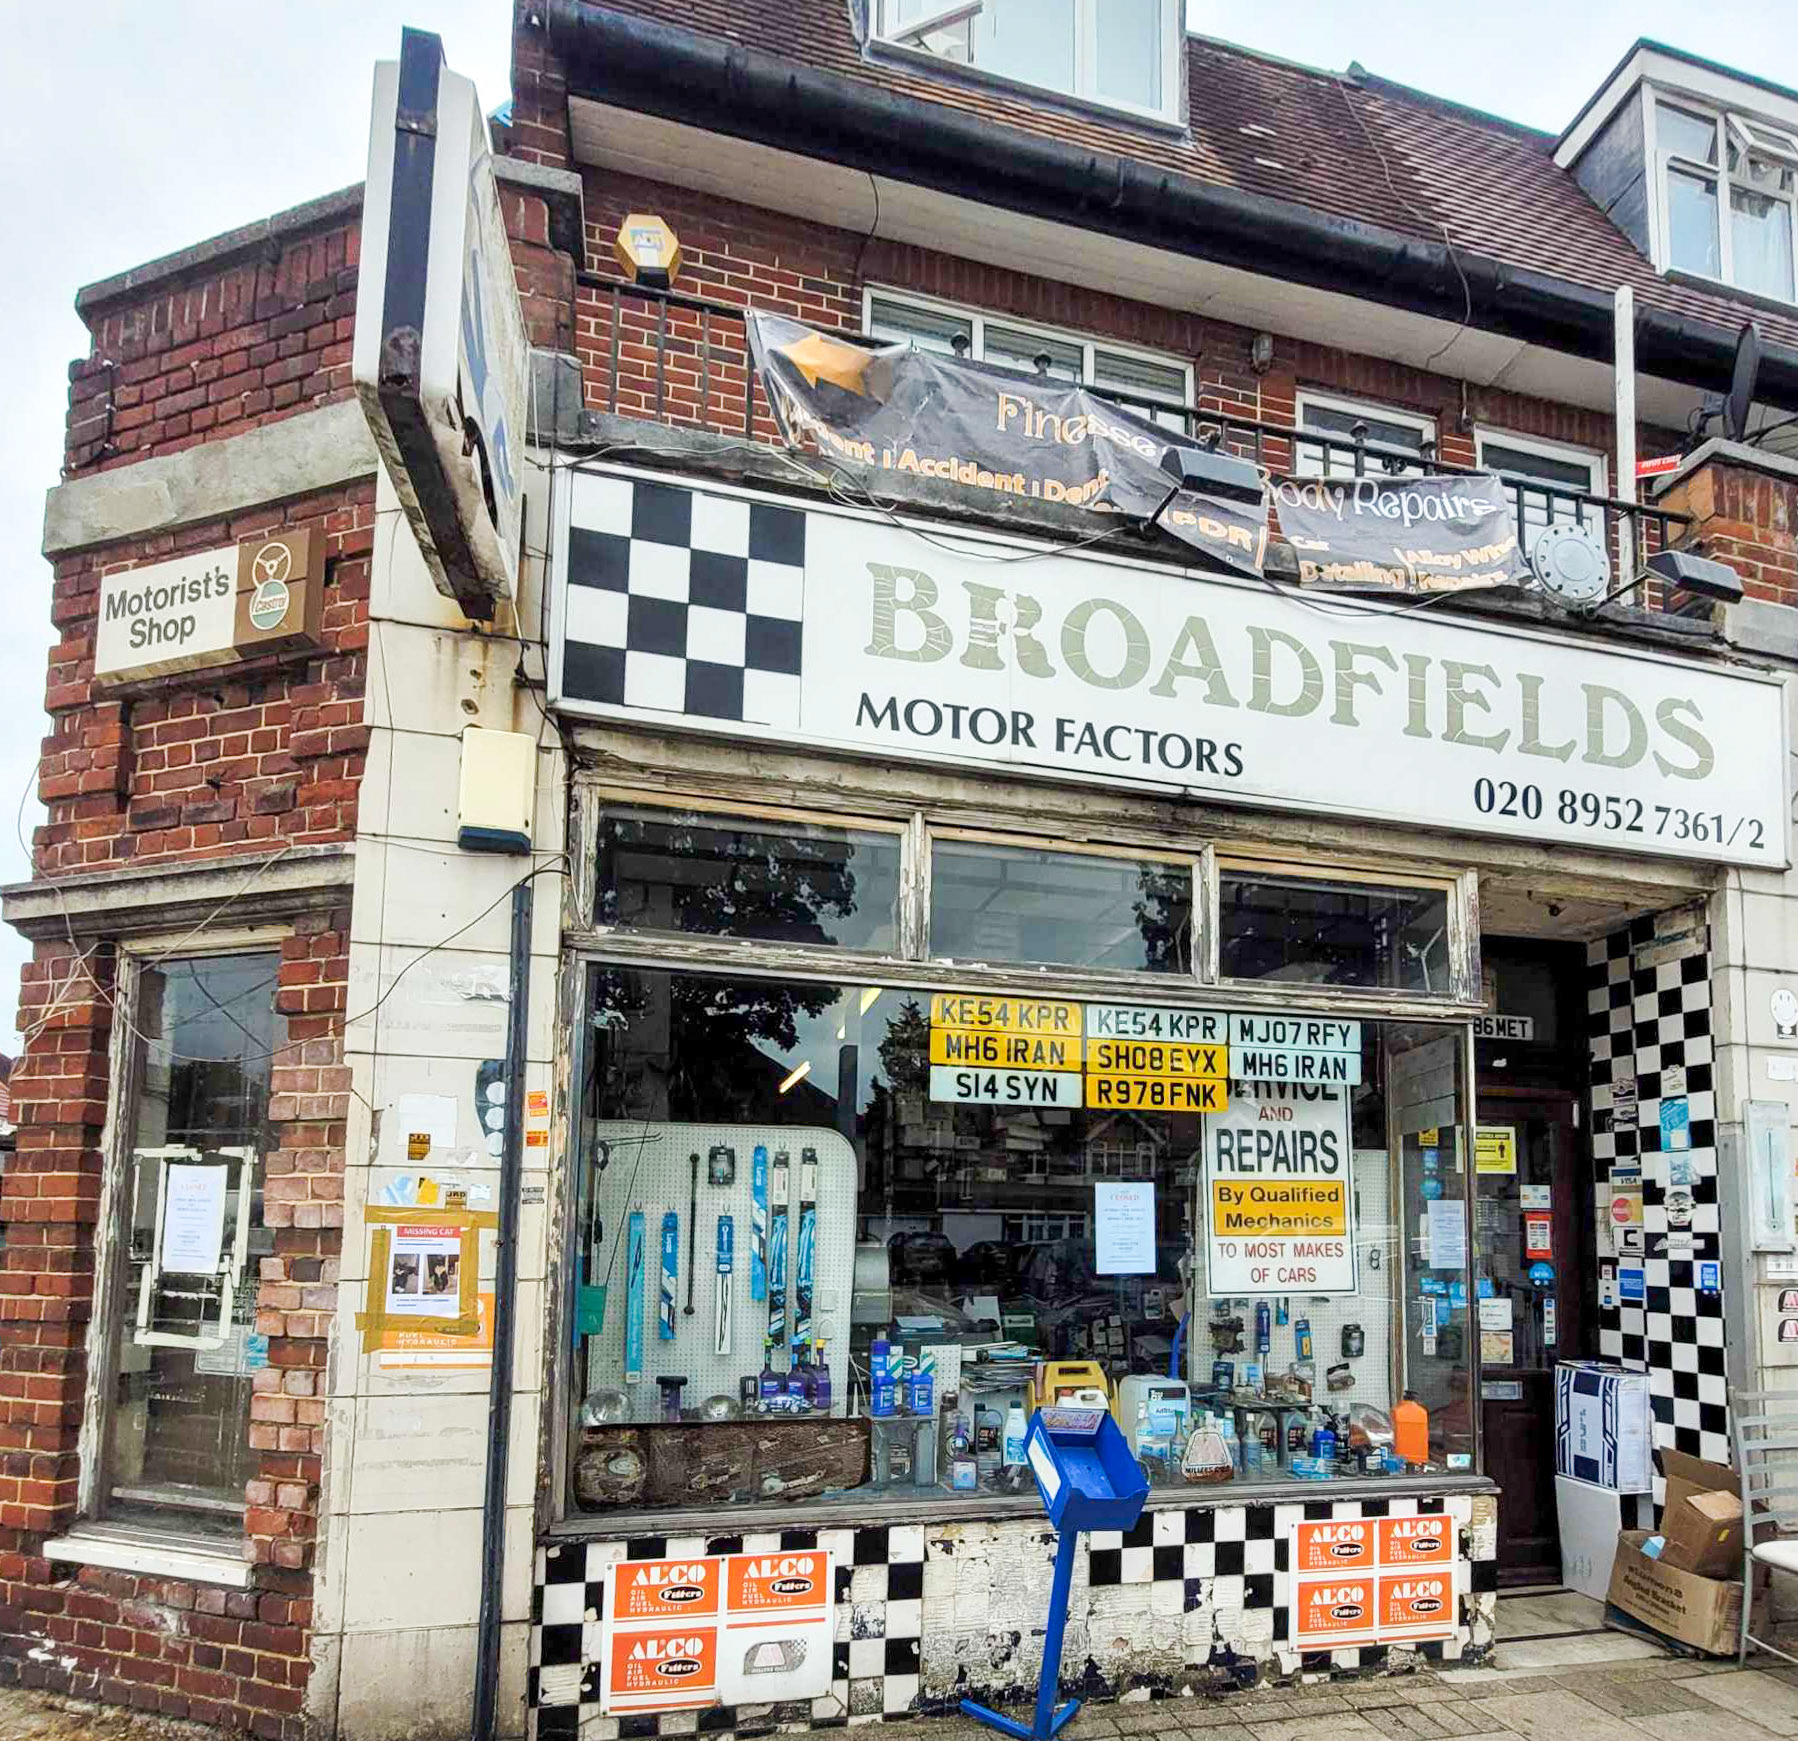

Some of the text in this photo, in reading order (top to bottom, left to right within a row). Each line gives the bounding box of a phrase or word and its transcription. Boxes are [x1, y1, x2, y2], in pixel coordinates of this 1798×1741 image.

[897, 448, 1025, 495] Accident
[1171, 510, 1253, 553] PDR
[1353, 477, 1497, 528] Repairs
[1300, 560, 1405, 590] Detailing
[105, 565, 230, 622] Motorist's
[129, 614, 196, 650] Shop
[864, 561, 1715, 781] BROADFIELDS
[856, 692, 1243, 777] MOTOR FACTORS
[1473, 776, 1766, 850] 020 8952 7361/2
[940, 998, 1070, 1031] KE54 KPR
[1097, 1009, 1217, 1041] KE54 KPR
[1306, 1022, 1352, 1049] RFY
[1496, 1018, 1528, 1038] MET
[945, 1034, 998, 1061] MH6
[1097, 1044, 1217, 1075] SH08 EYX
[1242, 1051, 1290, 1077] MH6
[1006, 1075, 1058, 1103] SYN
[1097, 1079, 1216, 1108] R978 FNK
[1258, 1106, 1294, 1122] AND
[1215, 1128, 1340, 1175] REPAIRS
[1218, 1186, 1340, 1207] By Qualified
[403, 1227, 454, 1236] MISSING CAT
[1225, 1211, 1334, 1229] Mechanics
[1218, 1242, 1345, 1259] TO MOST MAKES
[1250, 1267, 1318, 1284] OF CARS
[1309, 1525, 1365, 1543] ALCO
[1390, 1520, 1443, 1538] ALCO
[631, 1564, 706, 1587] ALCO
[742, 1557, 815, 1580] ALCO
[742, 1597, 792, 1605] HYDRAULIC
[1309, 1586, 1364, 1605] ALCO
[1390, 1580, 1443, 1599] ALCO
[629, 1605, 682, 1613] HYDRAULIC
[1651, 1590, 1687, 1616] Bracket
[628, 1637, 704, 1660] ALCO
[626, 1678, 680, 1687] HYDRAULIC
